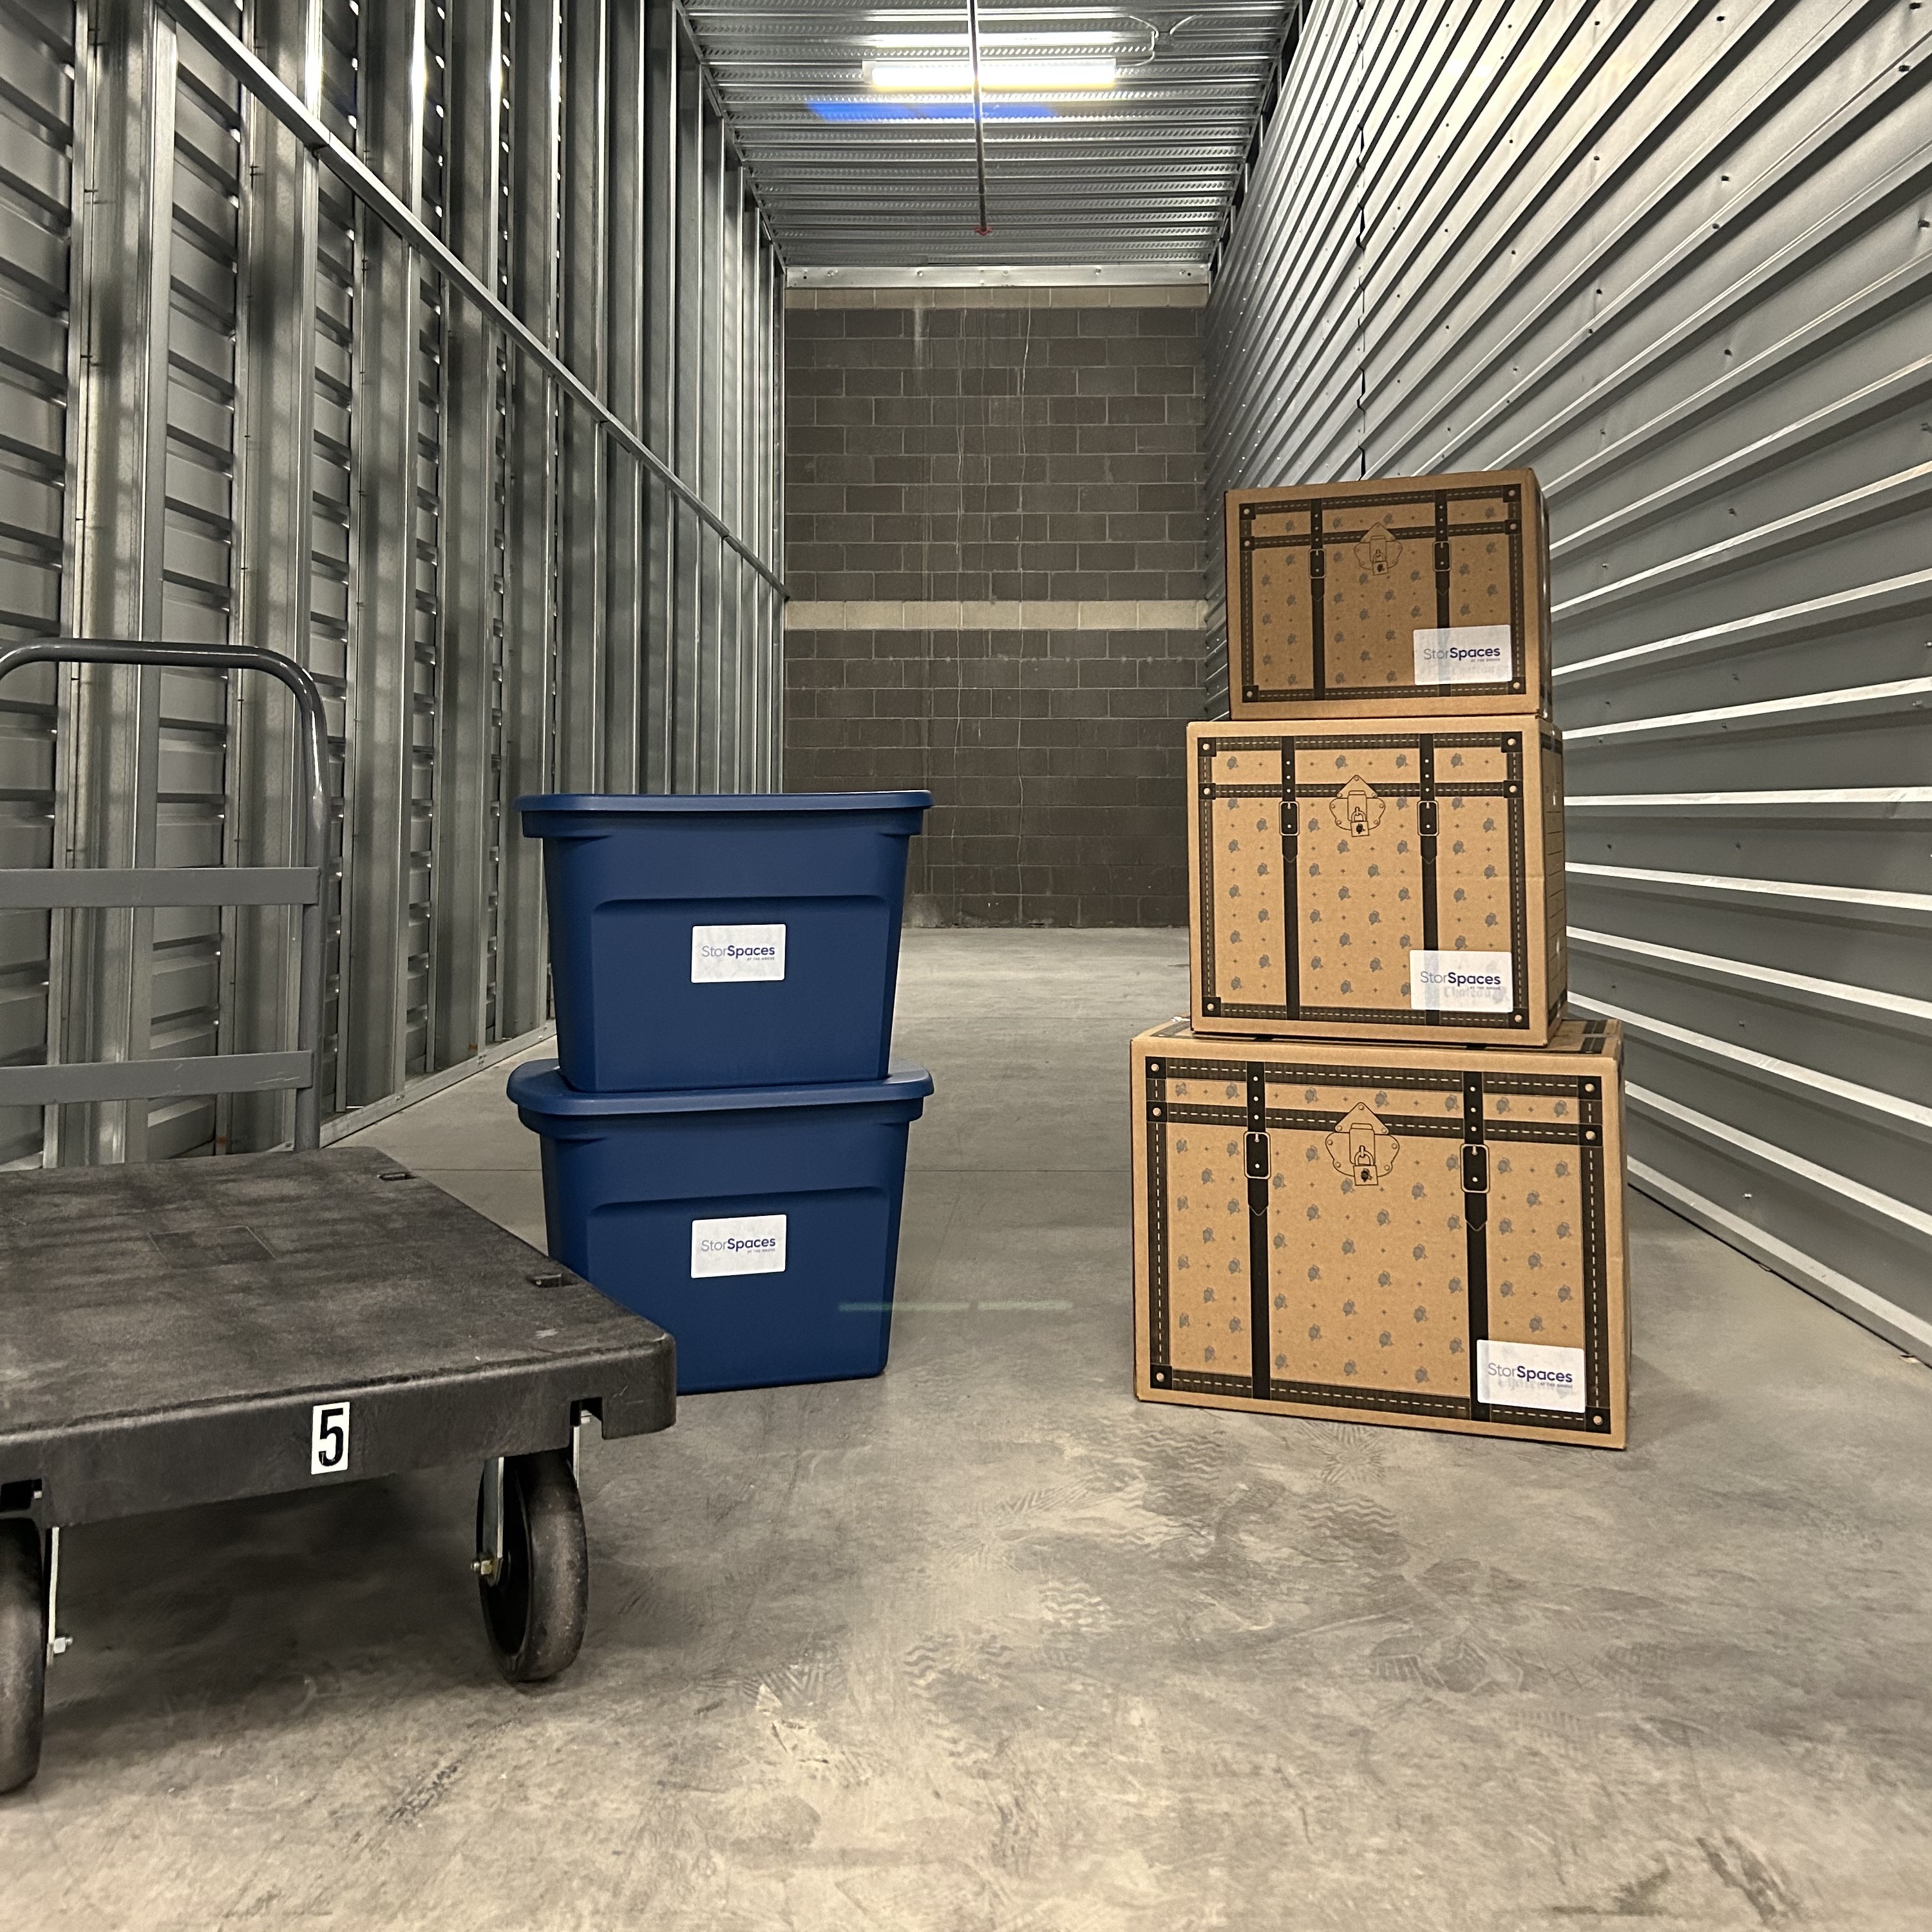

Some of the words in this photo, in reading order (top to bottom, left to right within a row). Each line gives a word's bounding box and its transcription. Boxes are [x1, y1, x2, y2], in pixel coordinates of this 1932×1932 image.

[1423, 647, 1501, 661] StorSpaces
[701, 945, 775, 960] StorSpaces
[1420, 971, 1501, 987] StorSpaces
[701, 1238, 776, 1253] StorSpaces
[1488, 1362, 1573, 1383] StorSpaces
[318, 1408, 344, 1467] 5
